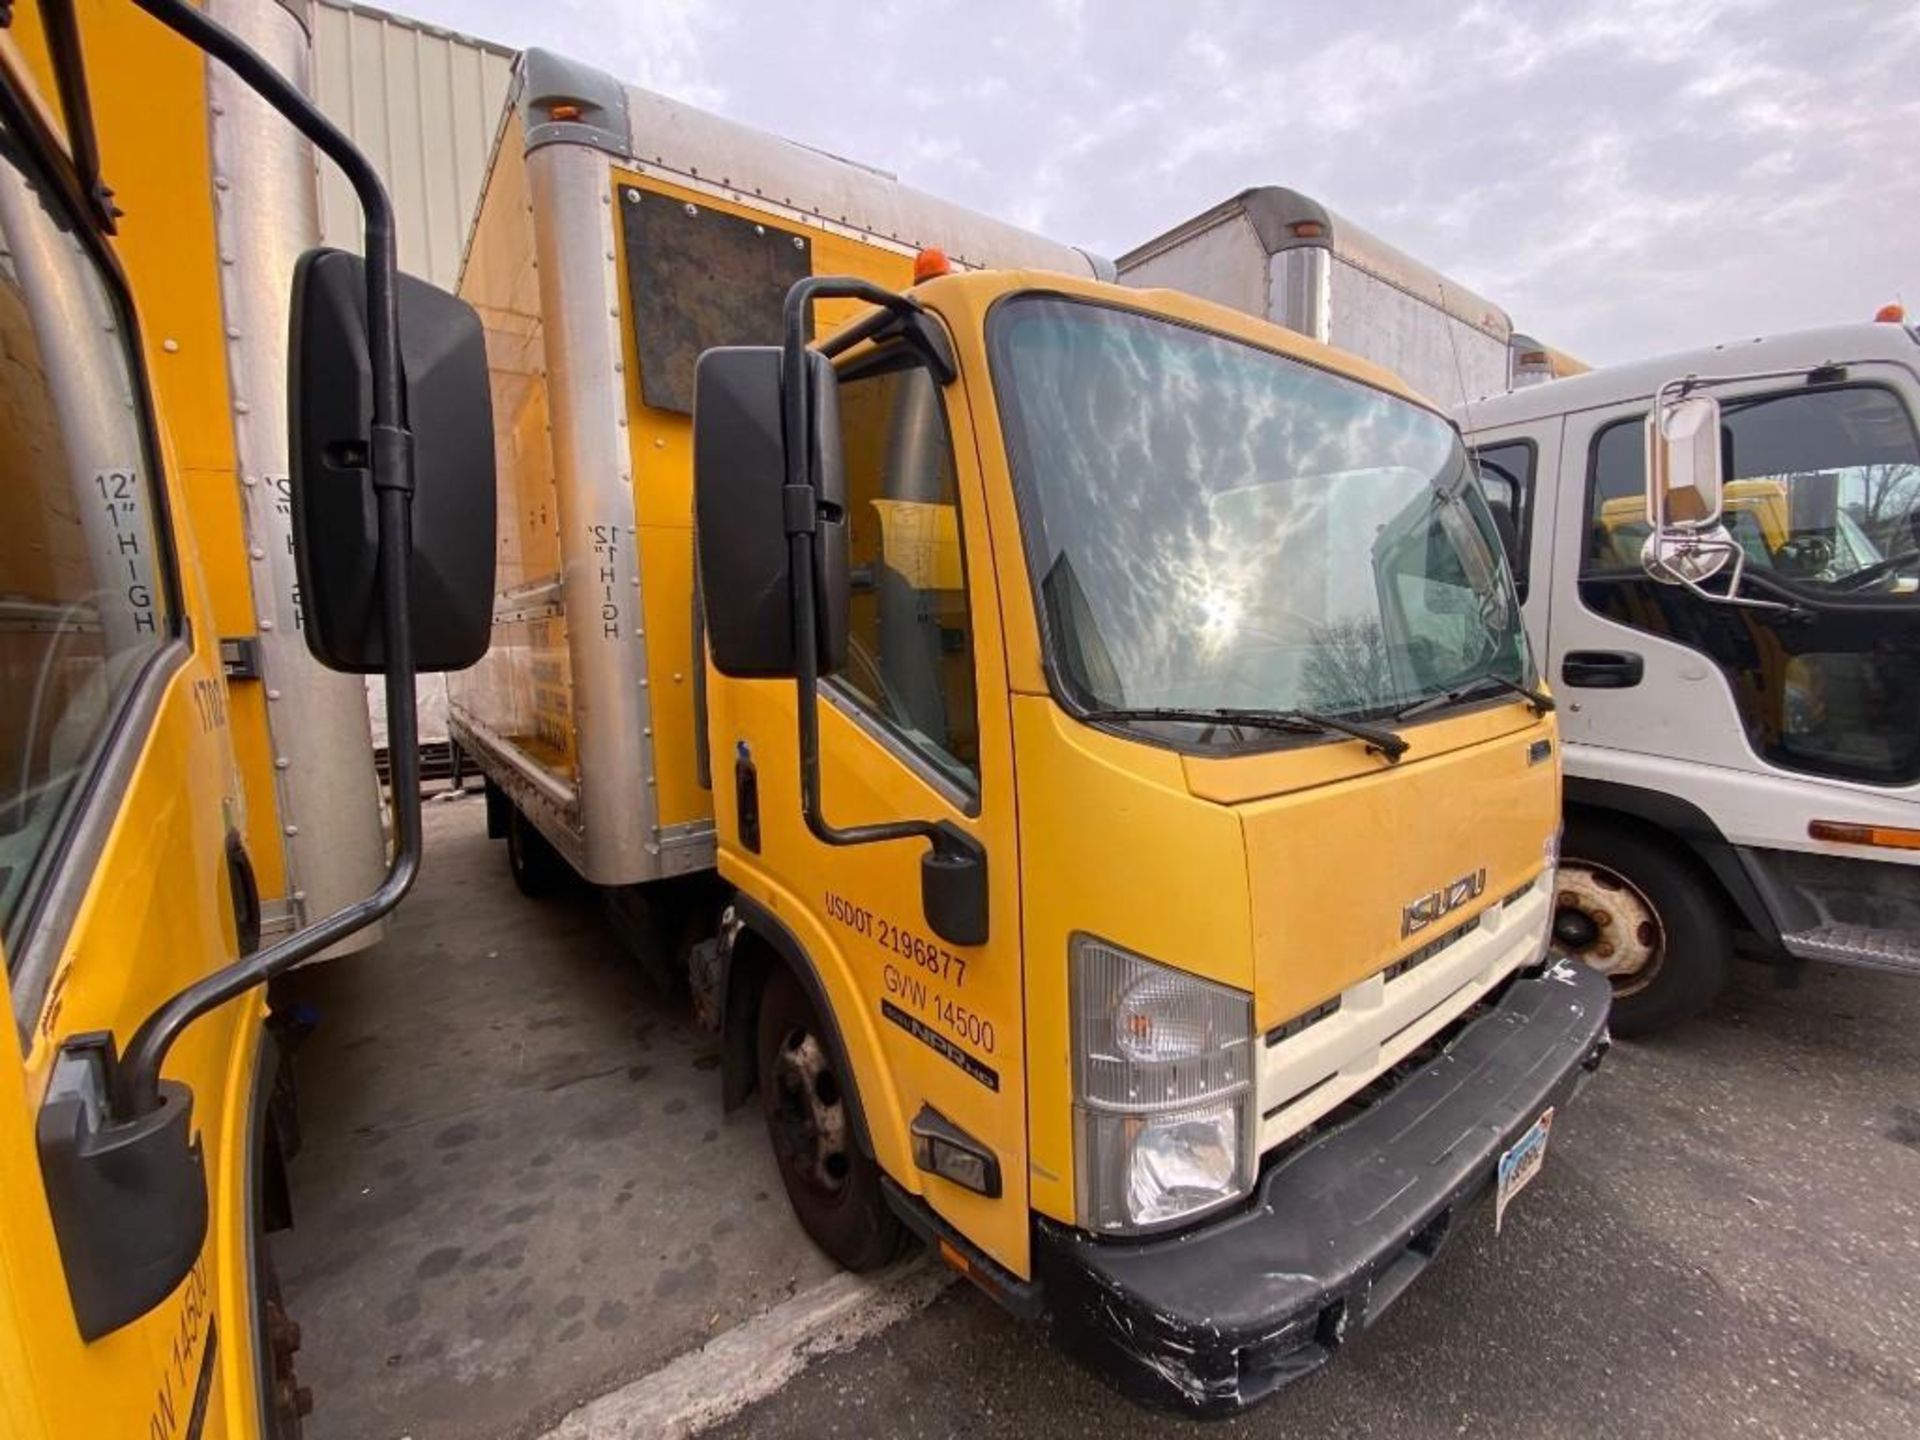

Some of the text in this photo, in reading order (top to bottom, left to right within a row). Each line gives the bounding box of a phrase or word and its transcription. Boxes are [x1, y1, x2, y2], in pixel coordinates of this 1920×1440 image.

[95, 473, 136, 500] 12'
[116, 532, 156, 634] HIGH
[825, 889, 967, 988] USDOT 2196877
[1401, 867, 1486, 940] ISUZU
[883, 963, 927, 1011] GVW
[934, 994, 995, 1054] 14500
